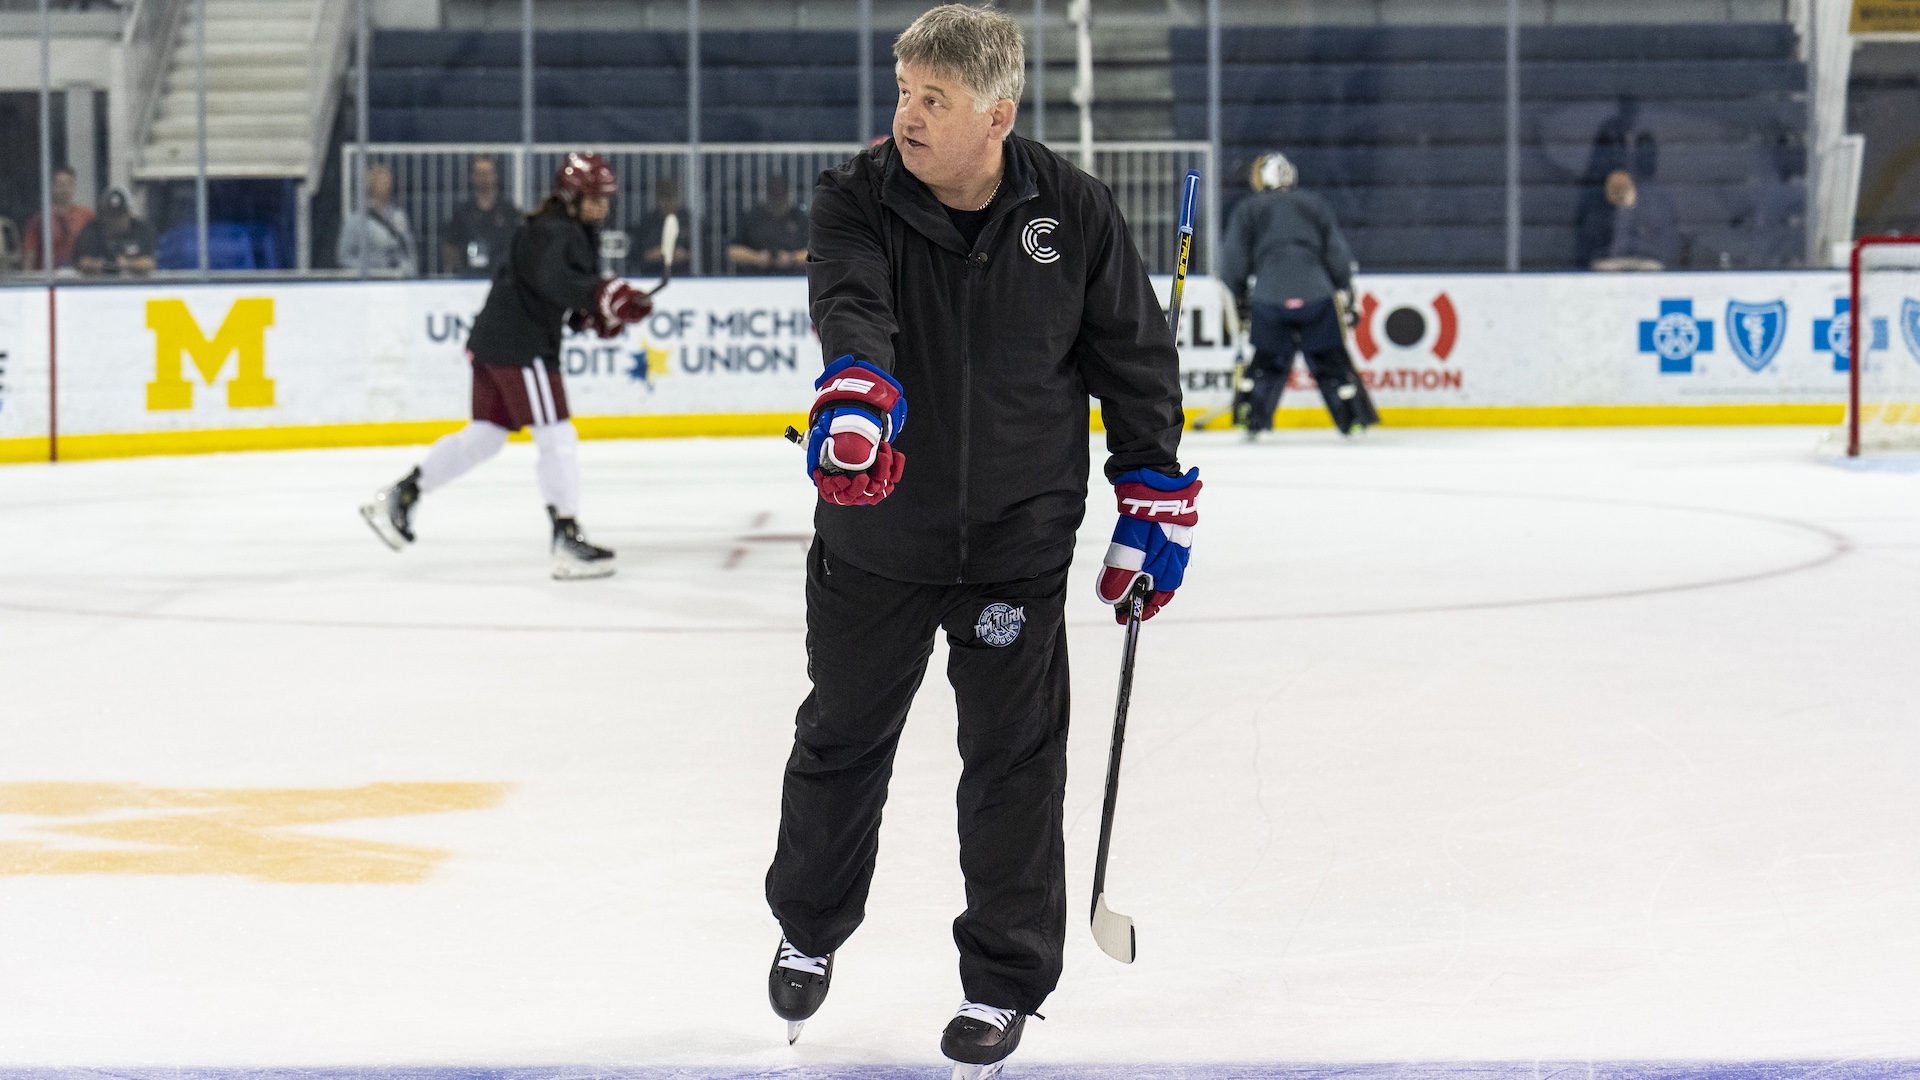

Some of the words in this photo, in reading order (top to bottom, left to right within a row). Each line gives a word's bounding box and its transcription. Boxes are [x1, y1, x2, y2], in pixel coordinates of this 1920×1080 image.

[1178, 235, 1189, 277] TRUE
[650, 311, 695, 339] OF
[707, 310, 809, 339] MICHI
[145, 297, 275, 411] M
[566, 347, 620, 375] DIT
[681, 345, 797, 375] UNION
[1121, 497, 1200, 517] TRU
[974, 621, 993, 639] TIM
[993, 606, 1027, 630] TURK
